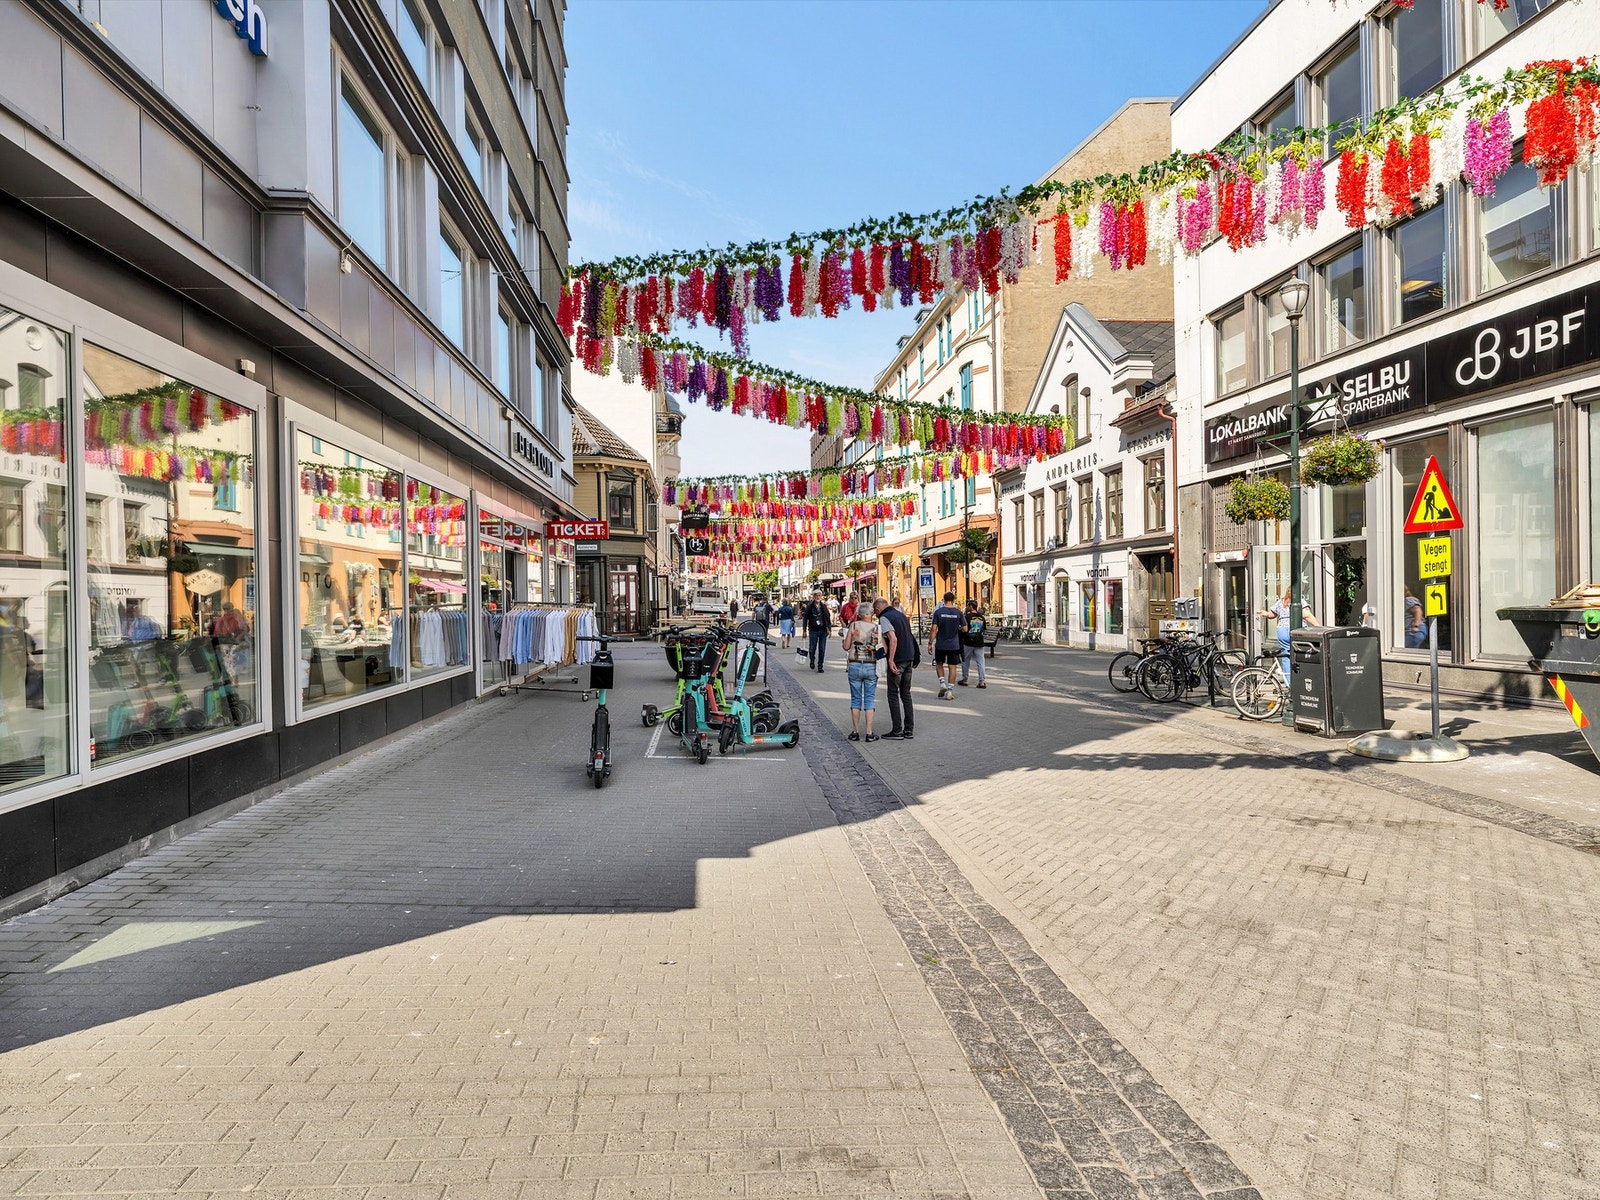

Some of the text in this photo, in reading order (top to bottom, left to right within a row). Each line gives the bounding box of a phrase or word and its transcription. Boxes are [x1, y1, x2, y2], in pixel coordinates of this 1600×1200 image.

[1509, 309, 1586, 359] JBF
[1342, 360, 1411, 401] SELBU
[1342, 385, 1411, 417] SPAREBANK
[514, 432, 553, 478] BERTONI
[551, 524, 603, 535] TICKET
[1423, 544, 1447, 557] Vegen
[1086, 566, 1109, 577] variant
[1424, 559, 1447, 573] stengt
